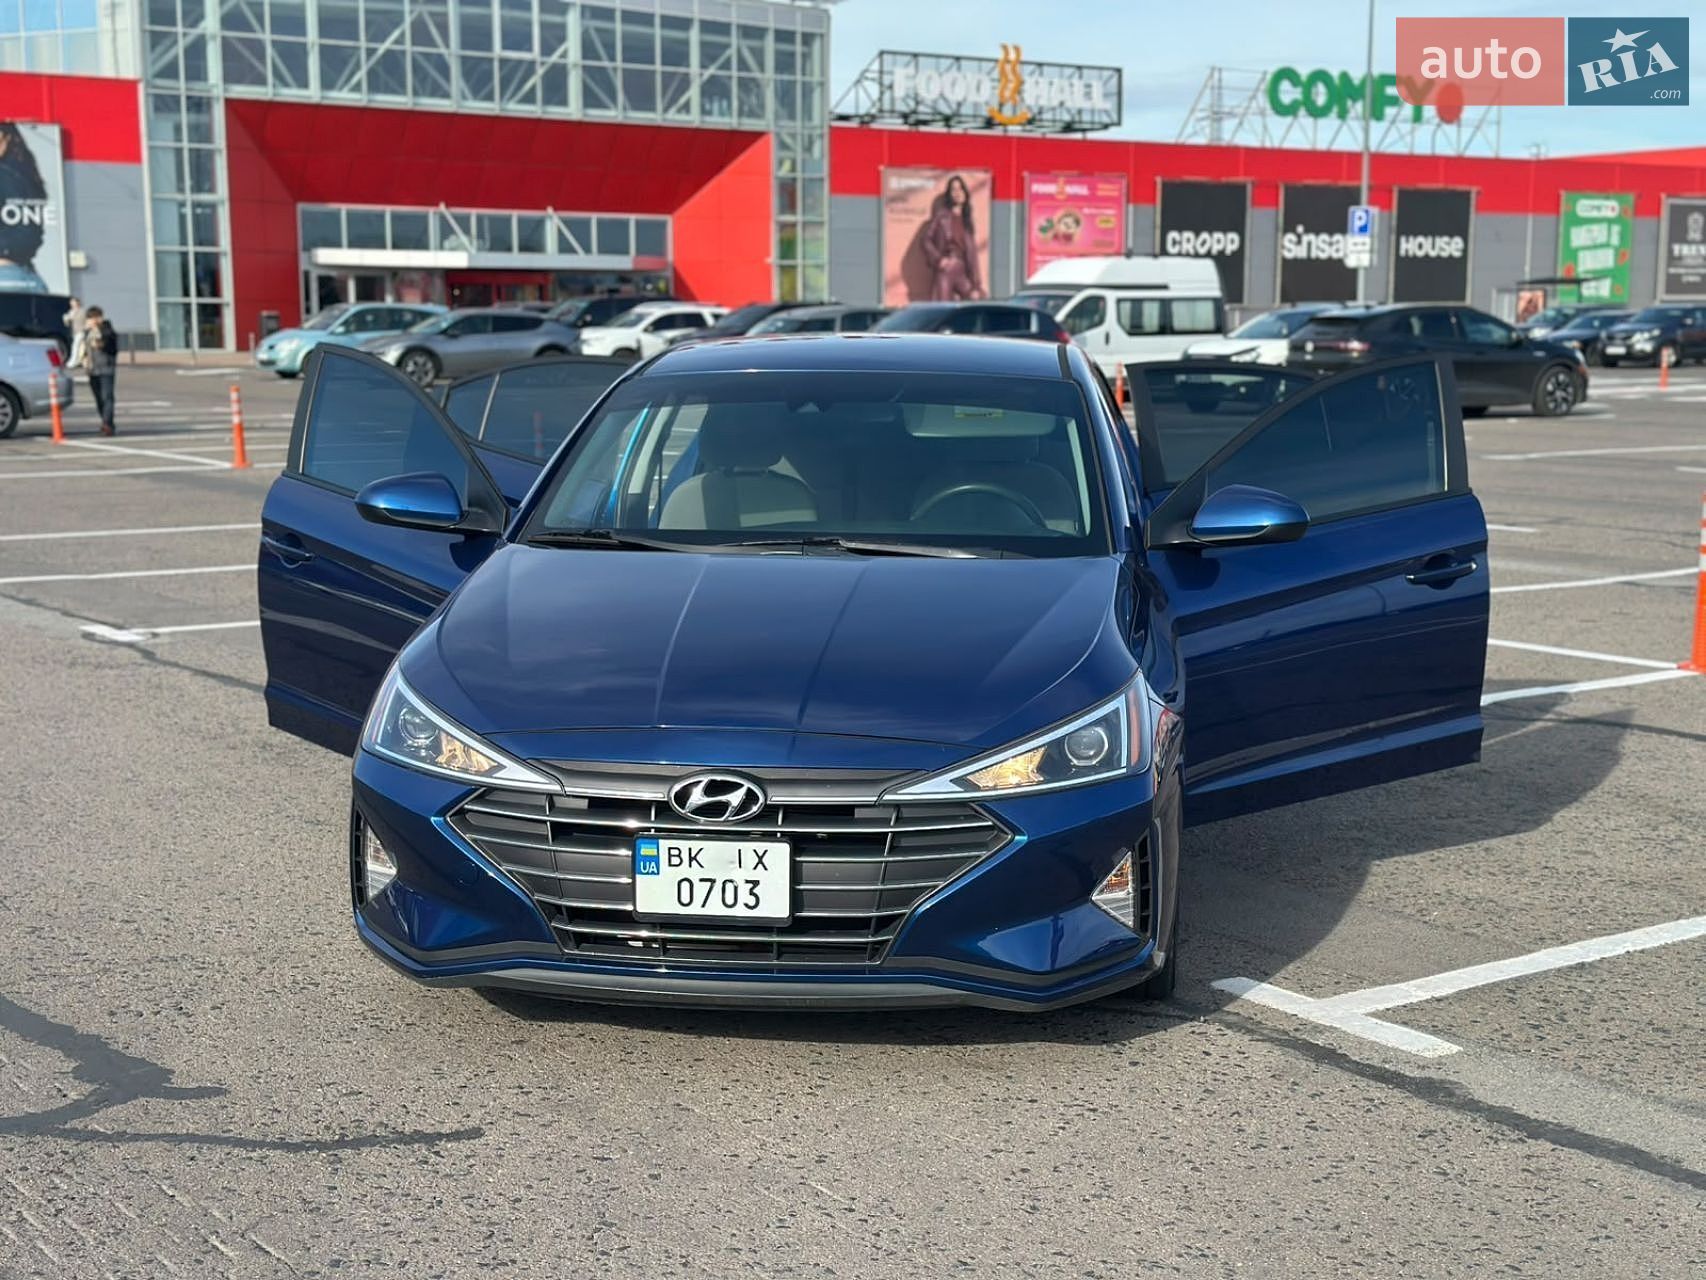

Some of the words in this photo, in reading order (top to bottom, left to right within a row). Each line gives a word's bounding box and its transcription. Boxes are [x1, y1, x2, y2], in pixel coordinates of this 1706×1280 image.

[893, 66, 990, 103] FOOD
[1022, 76, 1111, 109] HALL
[1268, 67, 1436, 123] COMFY
[1, 204, 57, 226] ONE
[1166, 230, 1240, 256] CROPP
[1282, 224, 1350, 260] sinsa
[640, 861, 658, 874] UA
[667, 846, 705, 869] BK
[736, 848, 769, 871] IX
[677, 877, 761, 910] 0703
